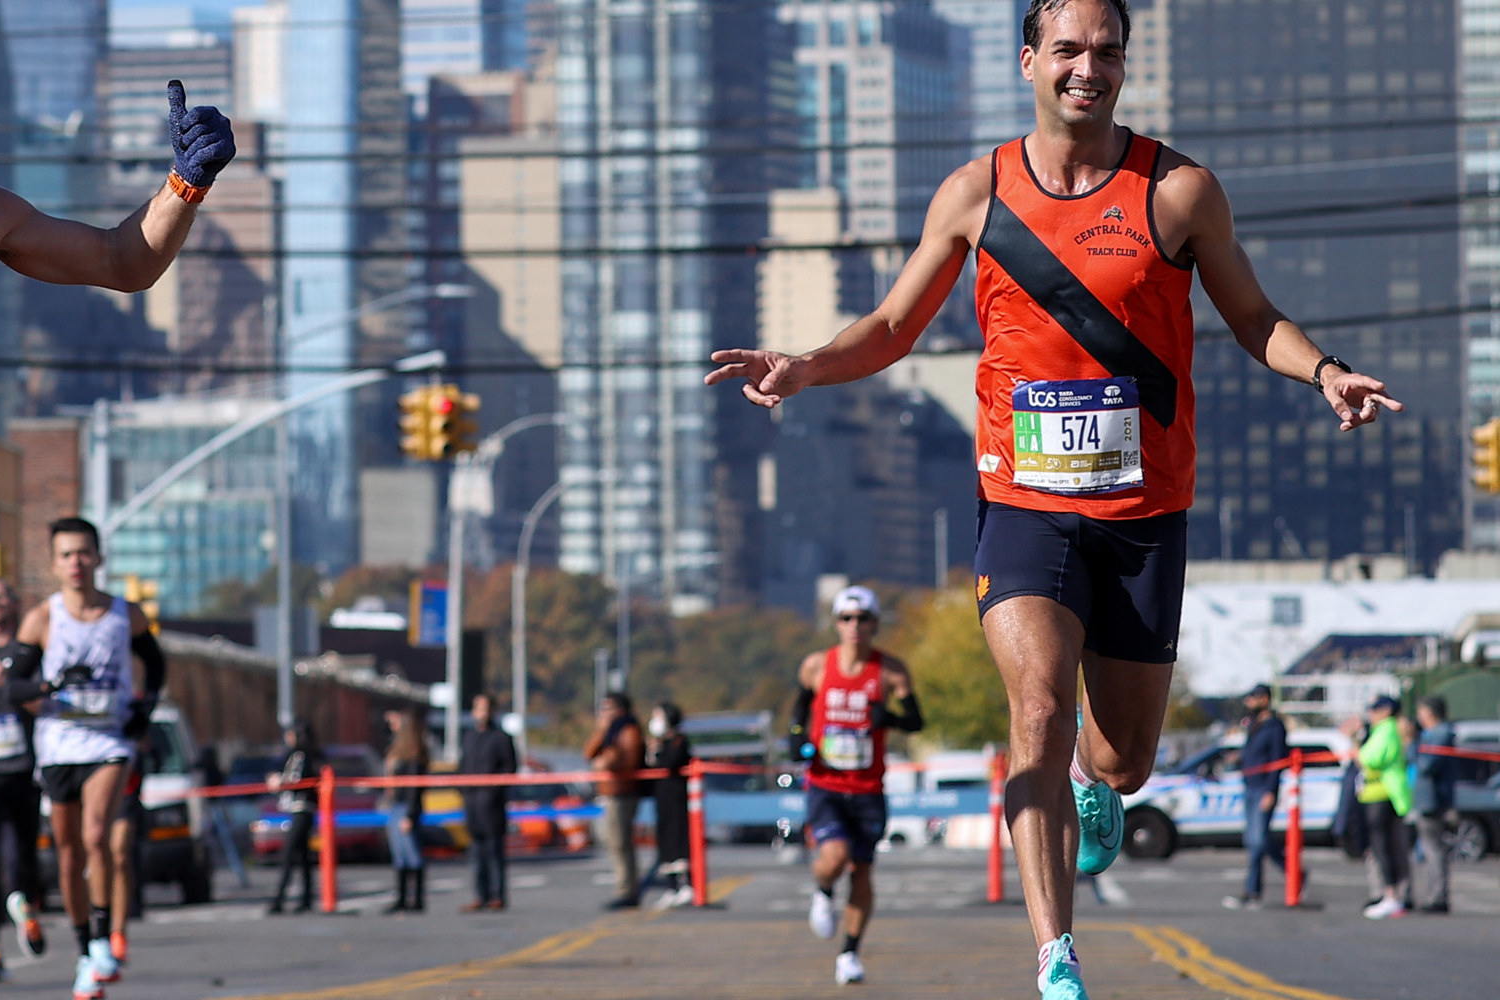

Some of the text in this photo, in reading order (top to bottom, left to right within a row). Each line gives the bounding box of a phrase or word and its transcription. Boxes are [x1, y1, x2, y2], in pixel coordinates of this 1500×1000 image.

[1074, 225, 1151, 248] CENTRAL PARK
[1087, 248, 1137, 257] TRACK CLUB
[1028, 387, 1057, 407] tcs
[1102, 397, 1124, 405] TATA
[1061, 414, 1101, 452] 574
[1124, 416, 1132, 442] 2021
[1030, 434, 1039, 452] A
